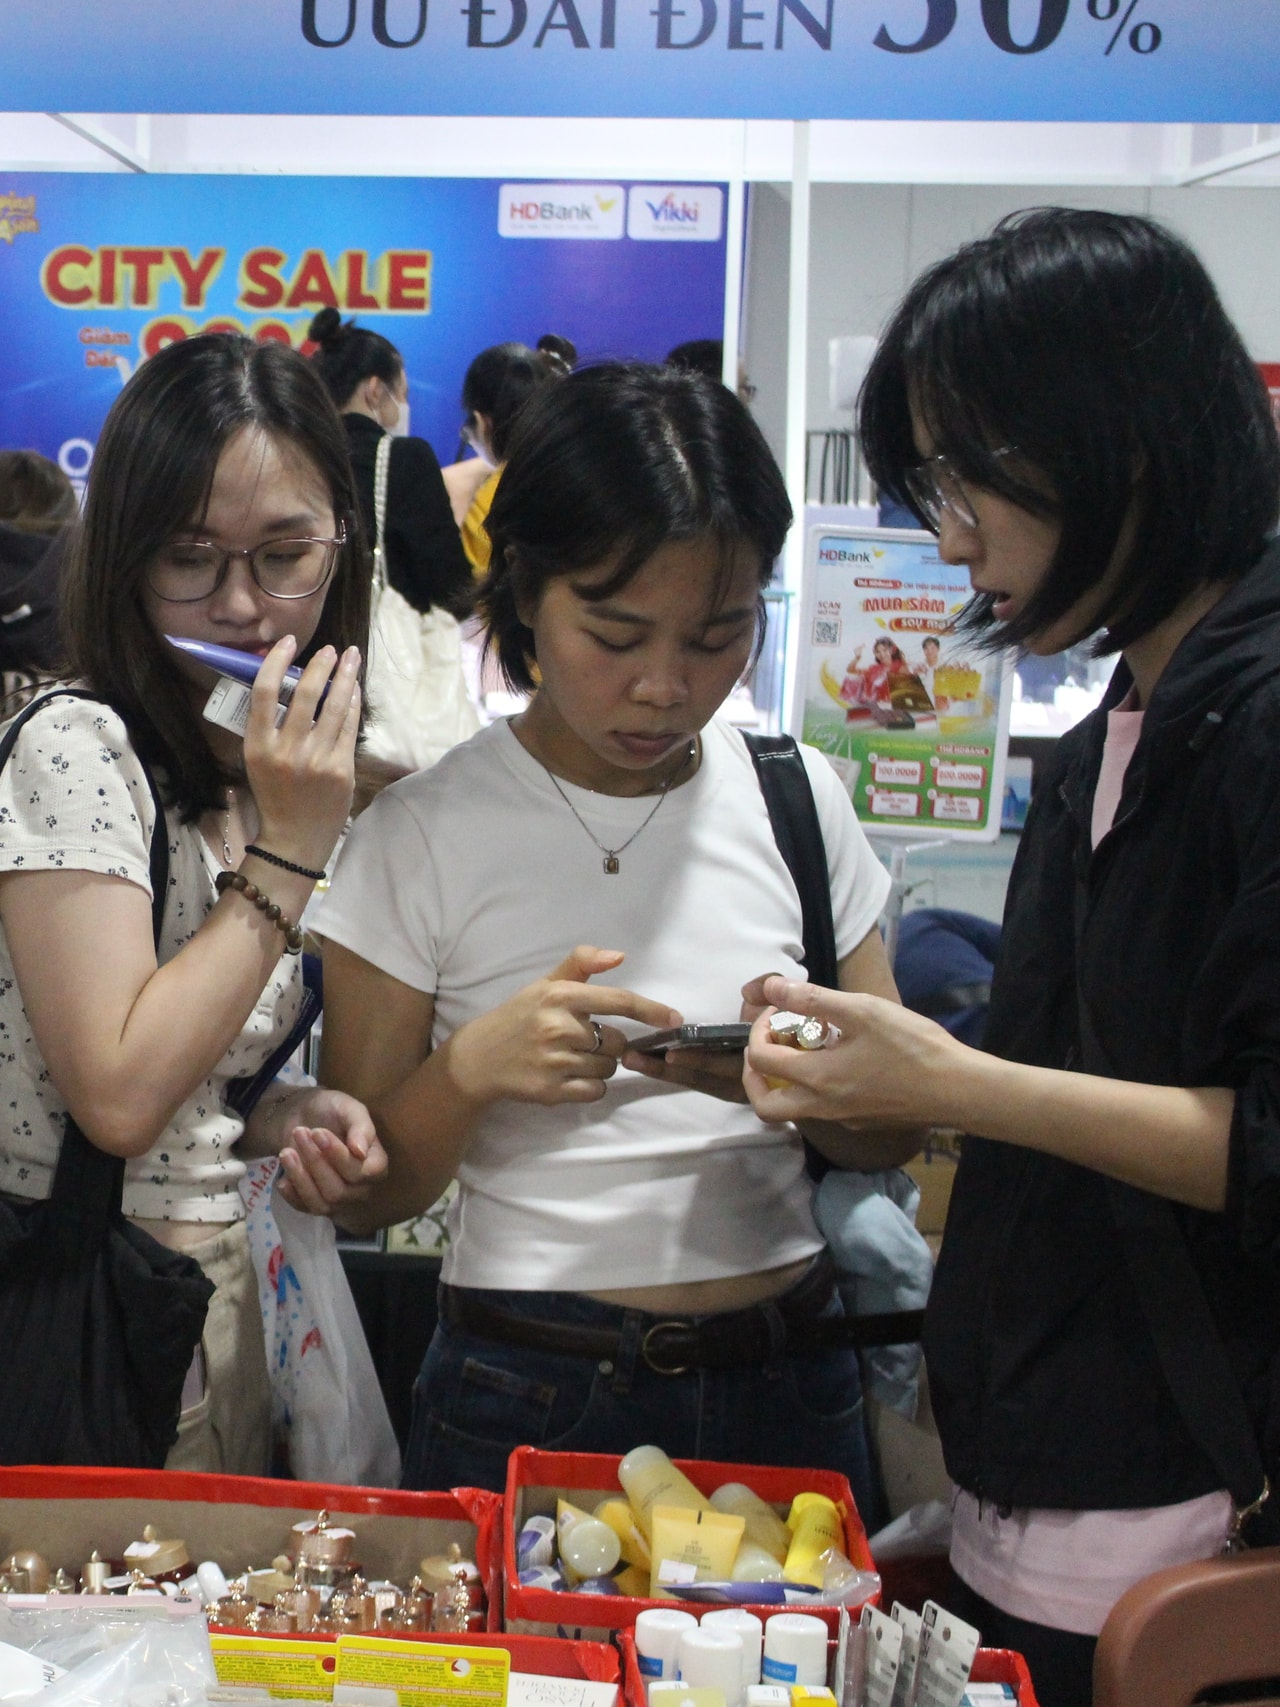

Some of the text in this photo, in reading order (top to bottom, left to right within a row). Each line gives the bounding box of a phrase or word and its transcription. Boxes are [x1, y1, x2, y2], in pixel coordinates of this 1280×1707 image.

[510, 203, 592, 220] HDBank
[646, 192, 699, 222] Vikki
[41, 246, 431, 314] CITY SALE
[820, 549, 870, 562] HDBank
[863, 597, 903, 612] MUA
